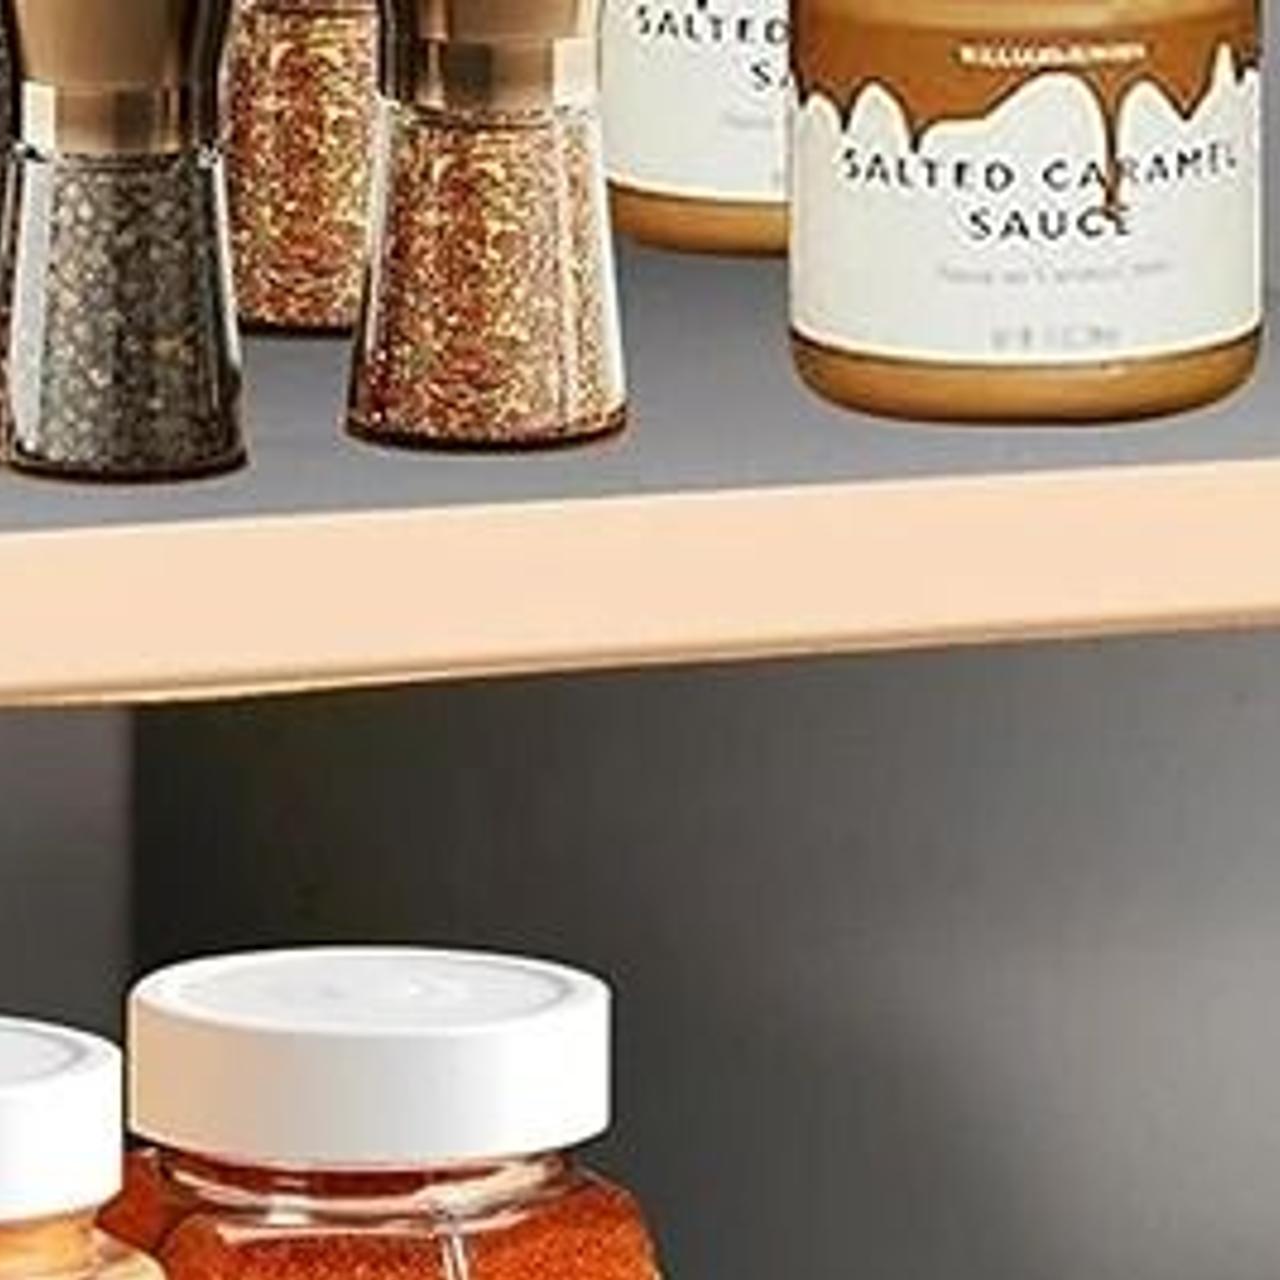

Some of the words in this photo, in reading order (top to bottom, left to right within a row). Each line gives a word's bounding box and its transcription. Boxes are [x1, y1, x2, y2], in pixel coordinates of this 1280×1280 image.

[637, 5, 790, 44] SALTED
[840, 146, 1017, 193] SALTED
[1041, 140, 1239, 192] CARAMEL
[967, 205, 1134, 241] SAUCE
